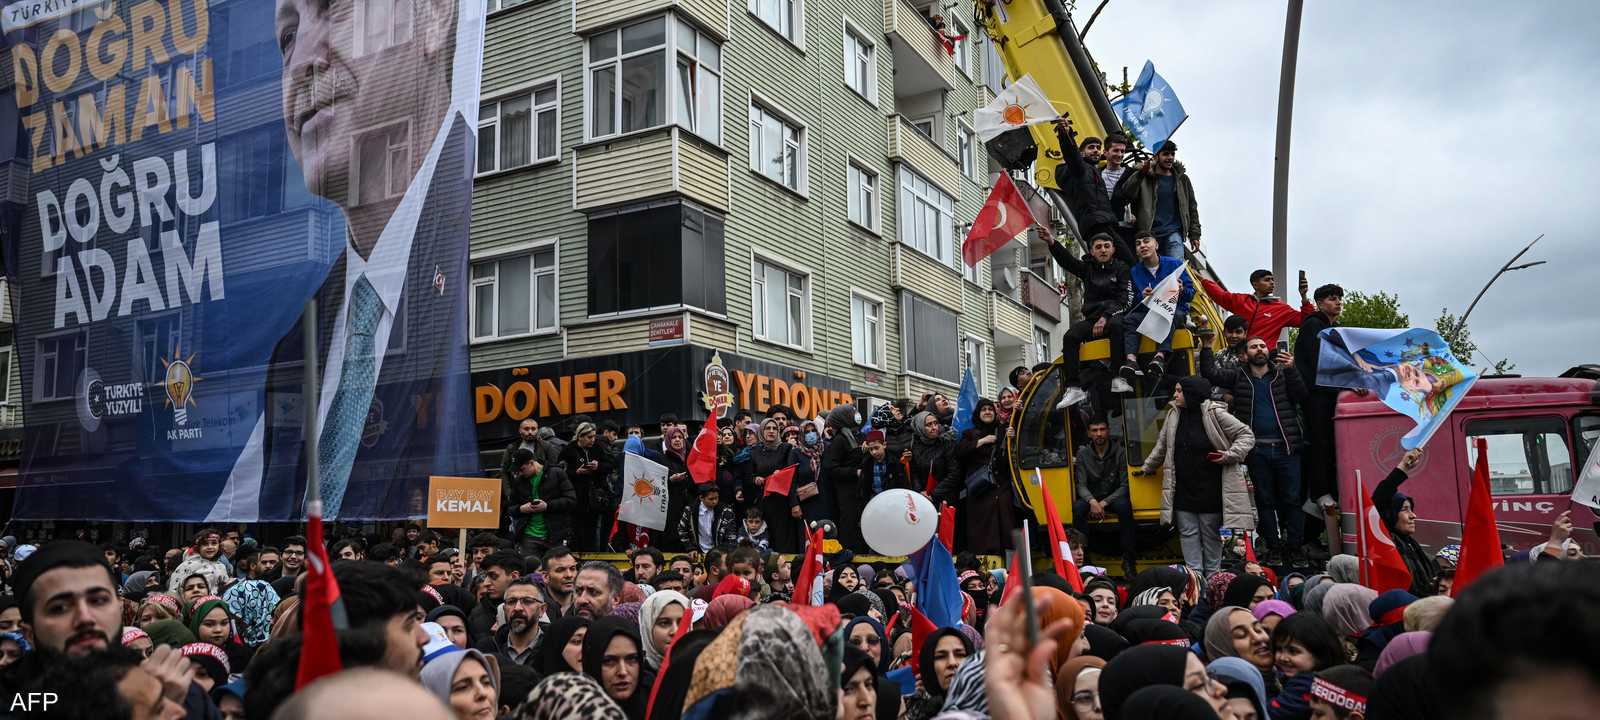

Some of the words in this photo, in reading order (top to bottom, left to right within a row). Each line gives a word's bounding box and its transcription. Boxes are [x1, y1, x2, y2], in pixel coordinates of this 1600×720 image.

[12, 0, 209, 108] DOĞRU
[22, 58, 216, 173] ZAMAN
[36, 142, 217, 252] DOĞRU
[54, 220, 225, 328] ADAM
[475, 367, 628, 424] DÖNER
[713, 379, 722, 392] YE
[167, 429, 178, 440] AK
[436, 499, 493, 513] KEMAL
